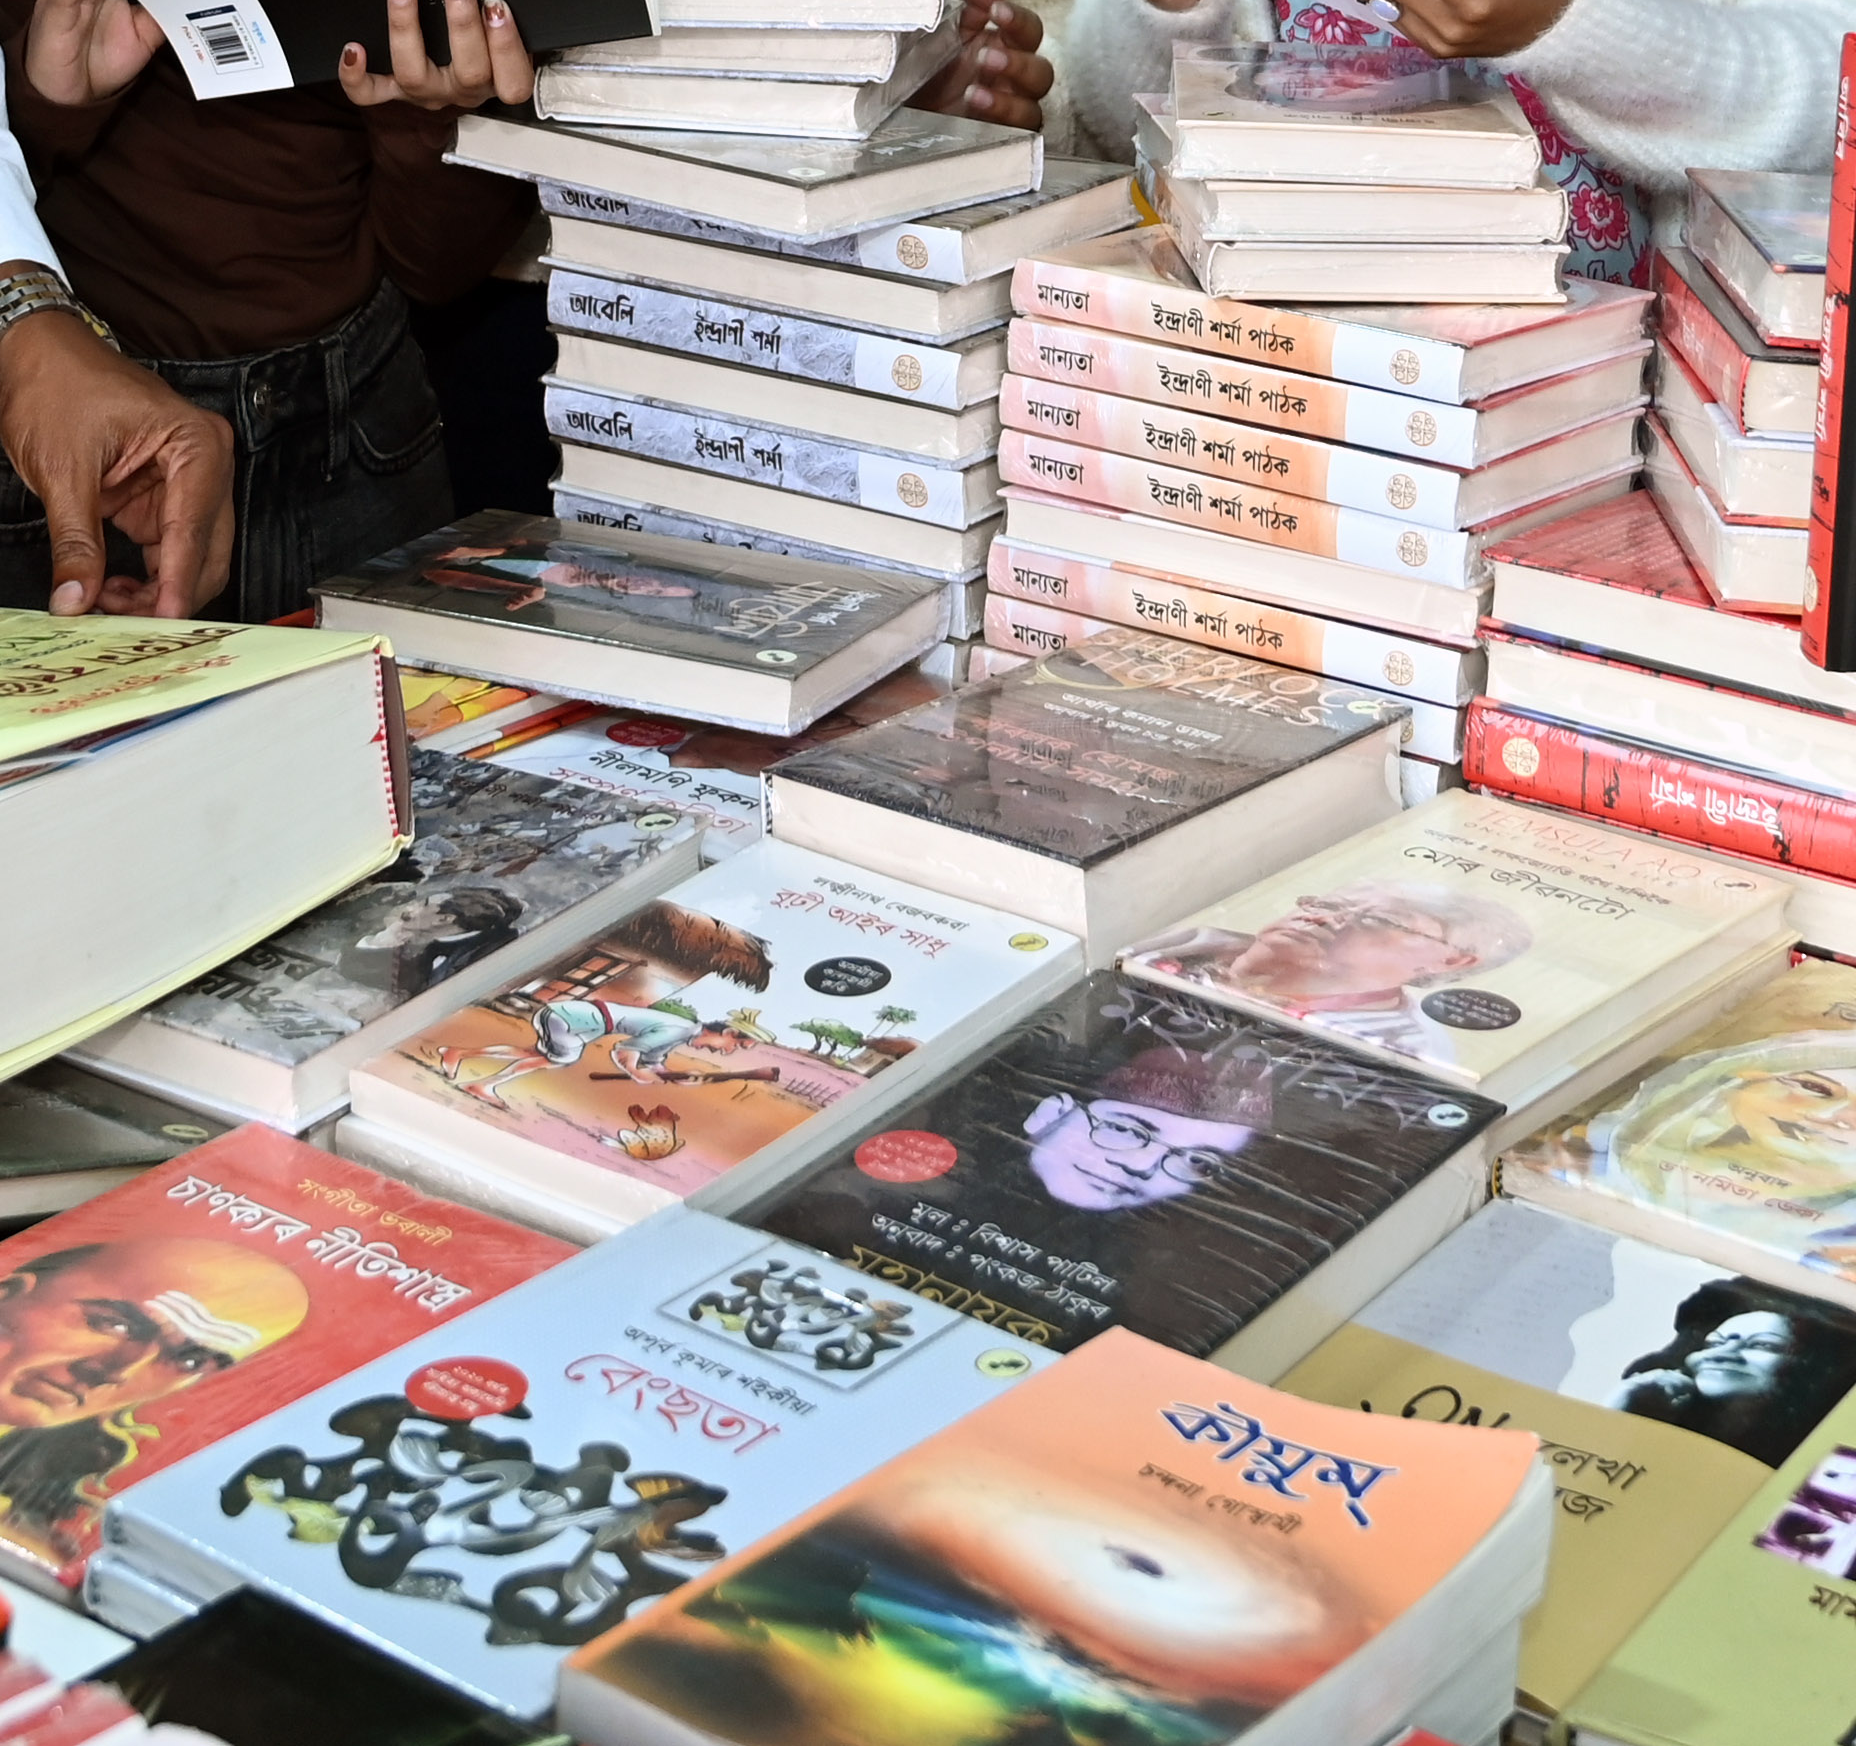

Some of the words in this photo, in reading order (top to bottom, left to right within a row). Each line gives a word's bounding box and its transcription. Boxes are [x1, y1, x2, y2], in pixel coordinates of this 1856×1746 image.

[569, 295, 634, 325] আবেলি
[1036, 280, 1091, 313] মান্যতা
[1248, 318, 1295, 356] পাঠক
[1039, 343, 1094, 377] মান্যতা
[1258, 380, 1307, 419] পাঠক
[566, 410, 633, 440] আবেলি
[1026, 399, 1081, 433] মান্যতা
[1241, 439, 1290, 478] পাঠক
[1403, 845, 1485, 875] মোৰ
[1477, 807, 1630, 864] TEMSULA
[1644, 856, 1703, 880] AO
[827, 903, 900, 940] আইৰ
[900, 929, 950, 958] সাধু
[166, 1174, 311, 1243] চাণক্যৰ
[871, 1211, 947, 1254] অনুবাদ
[1047, 1257, 1117, 1296] পাটিল
[677, 1348, 733, 1379] কুমাৰ
